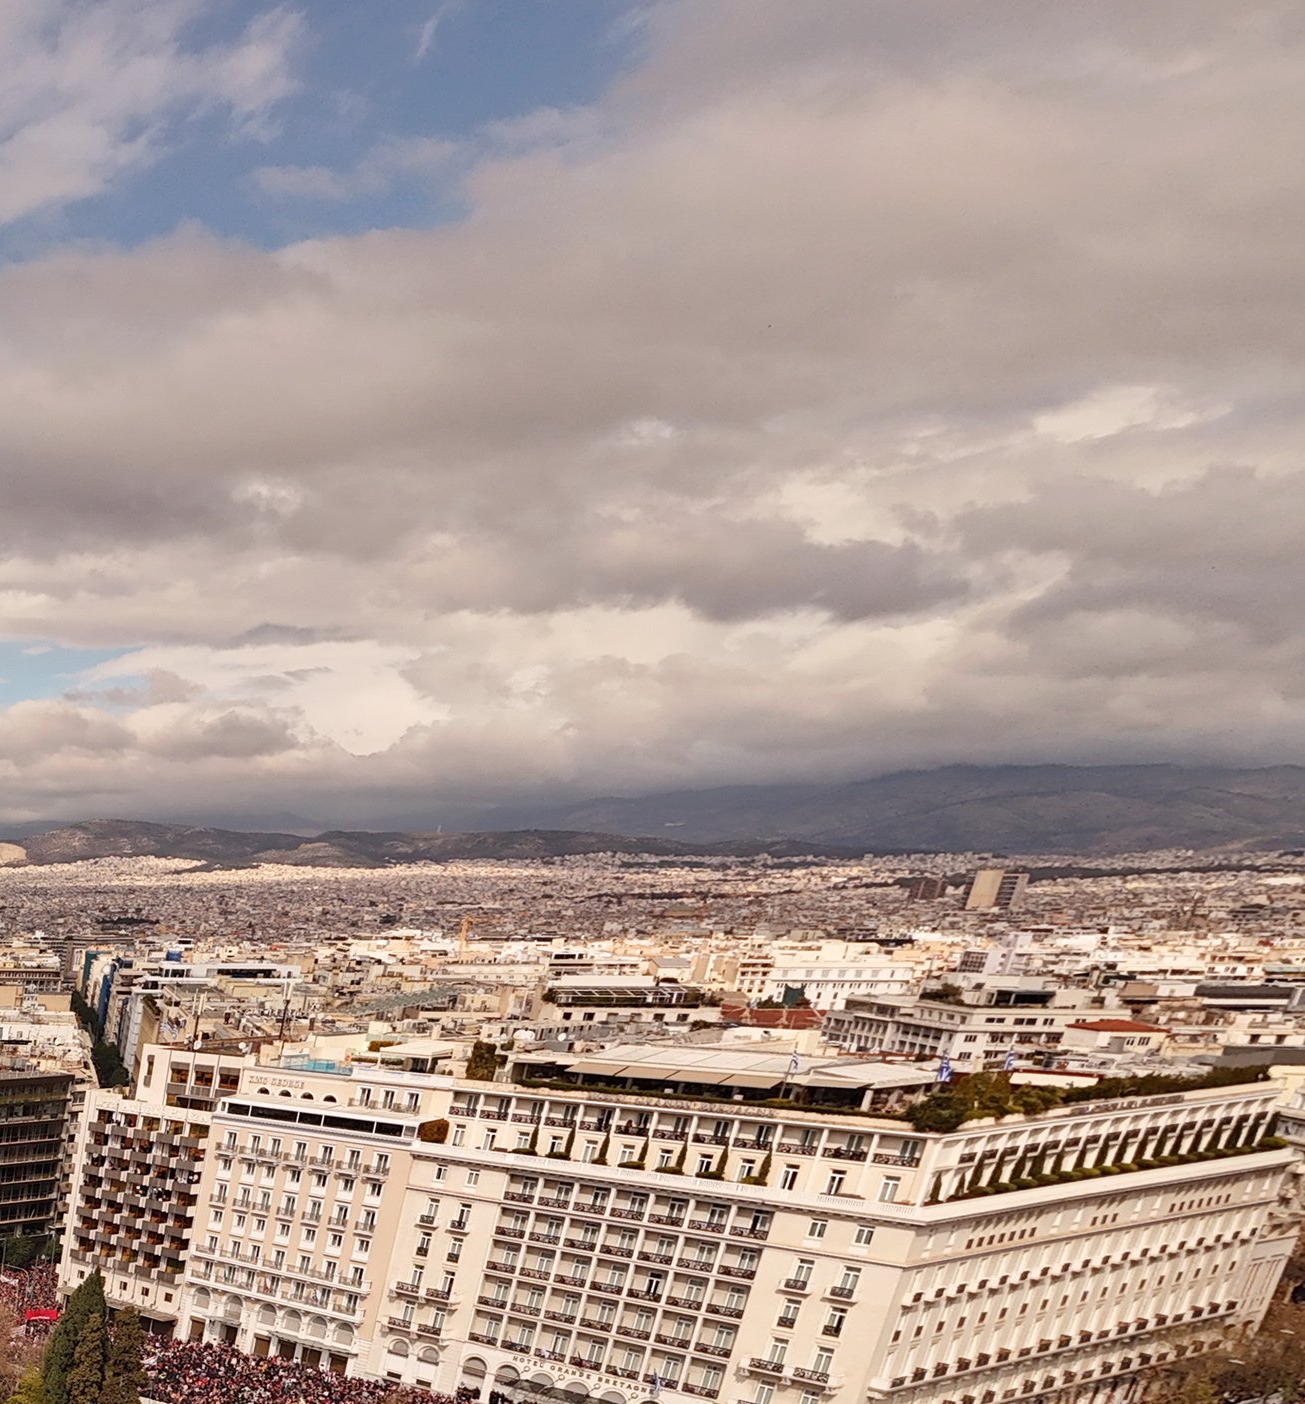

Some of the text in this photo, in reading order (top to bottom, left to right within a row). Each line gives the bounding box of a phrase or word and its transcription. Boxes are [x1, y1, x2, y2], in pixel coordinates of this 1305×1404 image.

[512, 1355, 654, 1395] HOTEL GRANDE BRETAGNE
